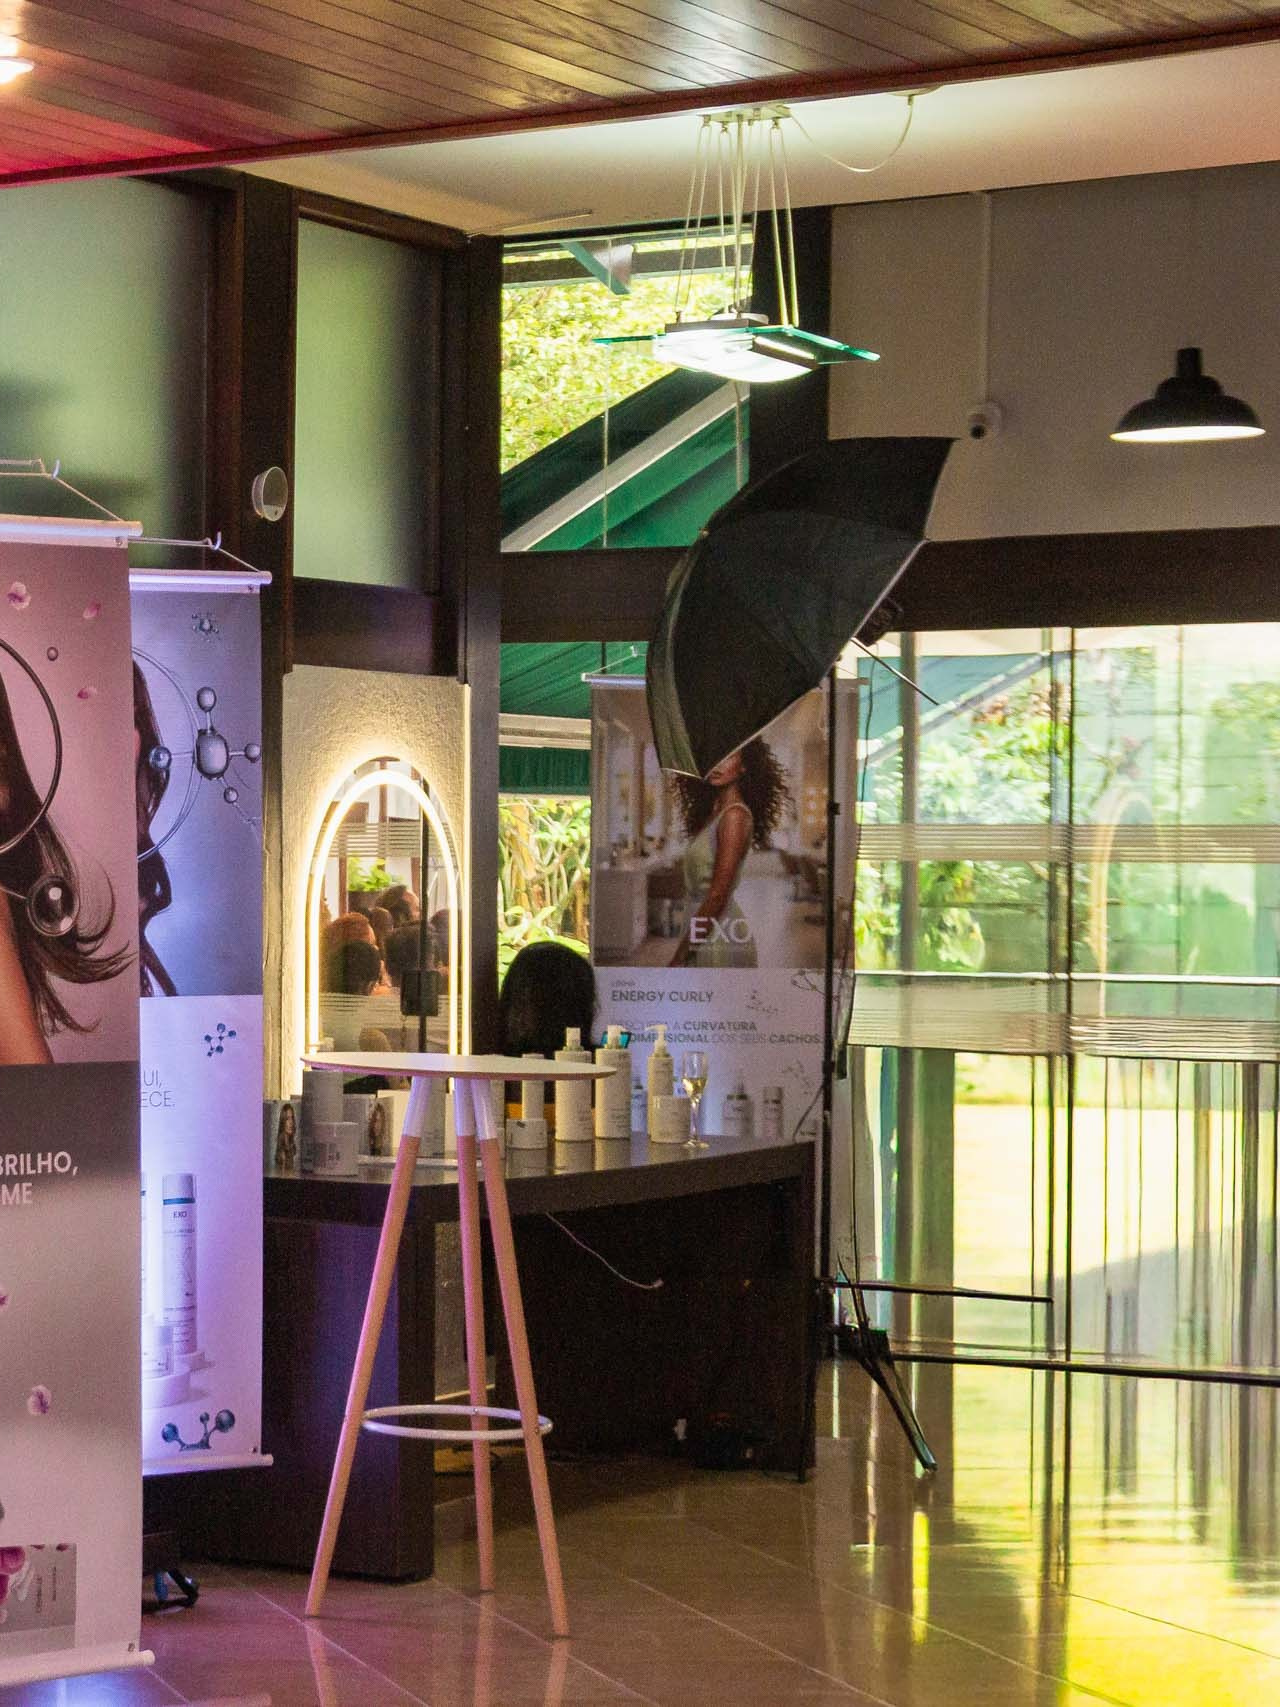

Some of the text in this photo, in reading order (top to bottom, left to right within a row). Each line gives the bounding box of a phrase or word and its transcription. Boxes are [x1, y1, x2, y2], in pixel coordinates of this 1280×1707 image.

[690, 917, 753, 943] EXO
[611, 990, 714, 1002] ENERGY CURLY
[683, 1021, 757, 1032] CURVATURA
